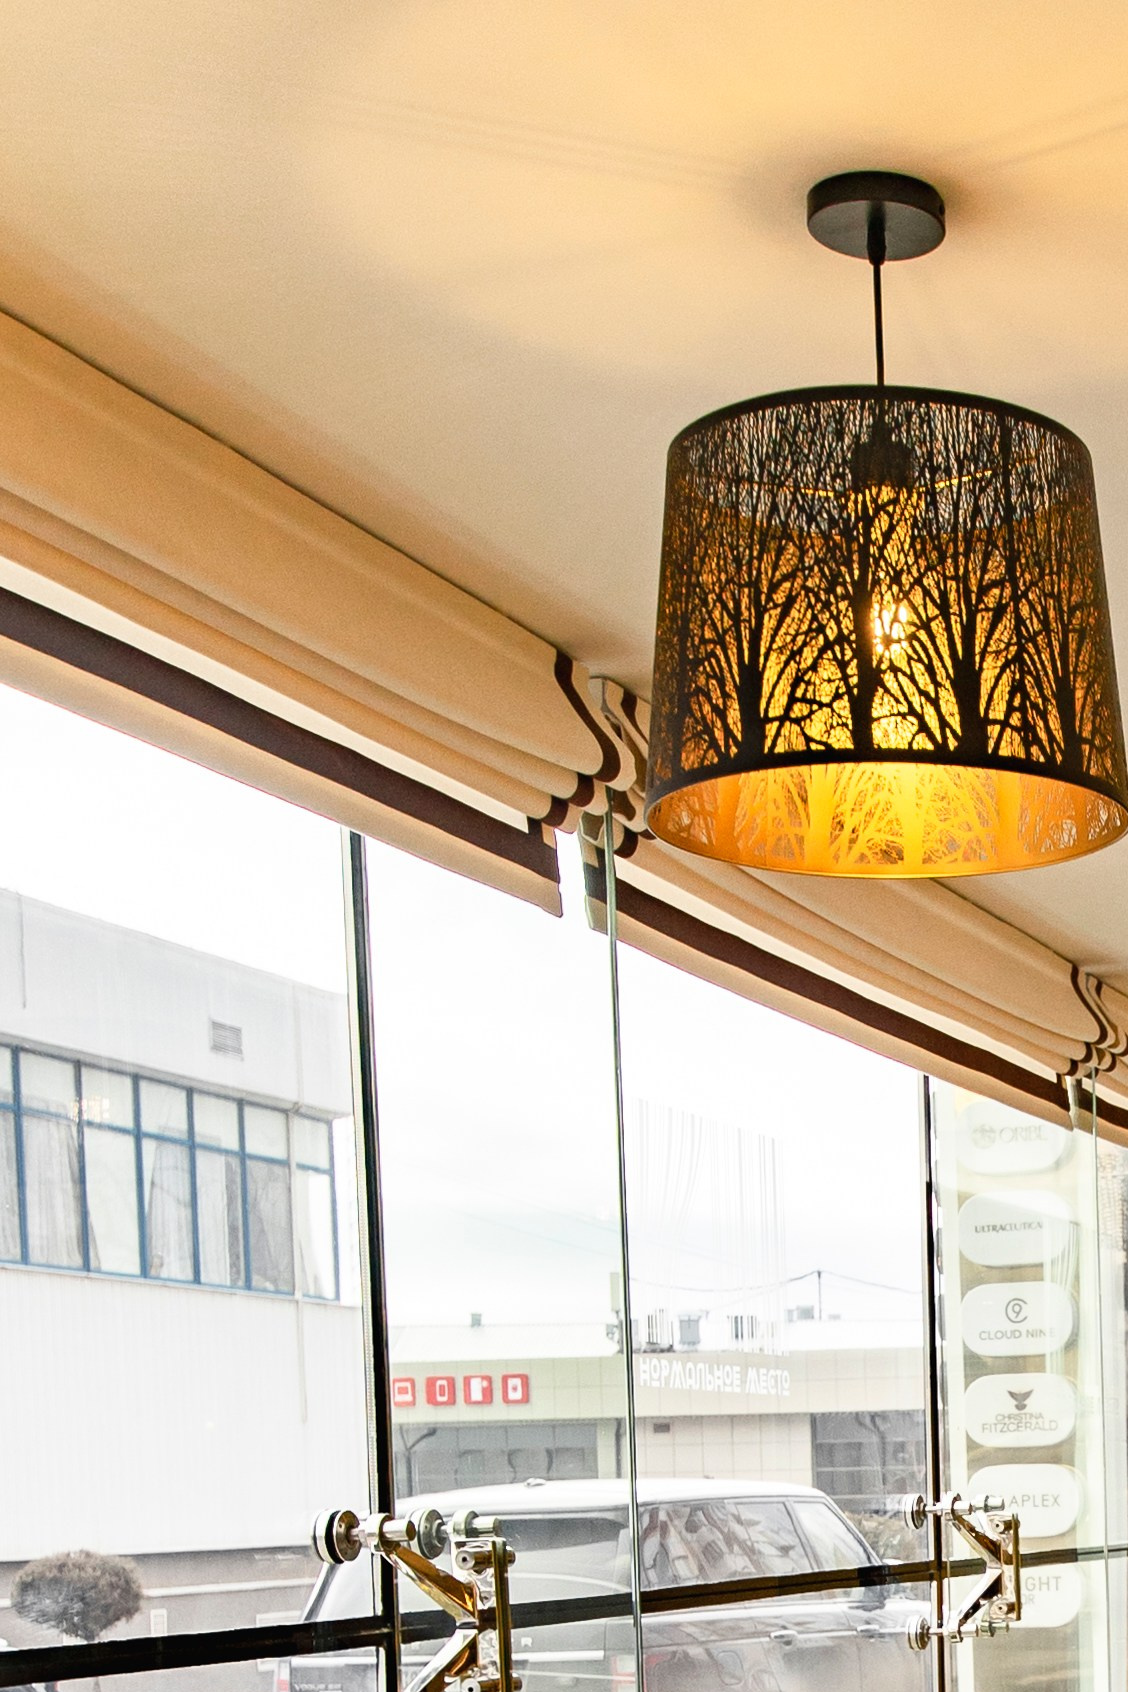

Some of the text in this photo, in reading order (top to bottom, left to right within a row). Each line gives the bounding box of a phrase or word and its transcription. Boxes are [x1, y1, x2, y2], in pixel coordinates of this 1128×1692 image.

[978, 1329, 1022, 1341] CLOUD
[639, 1357, 790, 1396] НОРМАЛЬНОЕ МЕСТО
